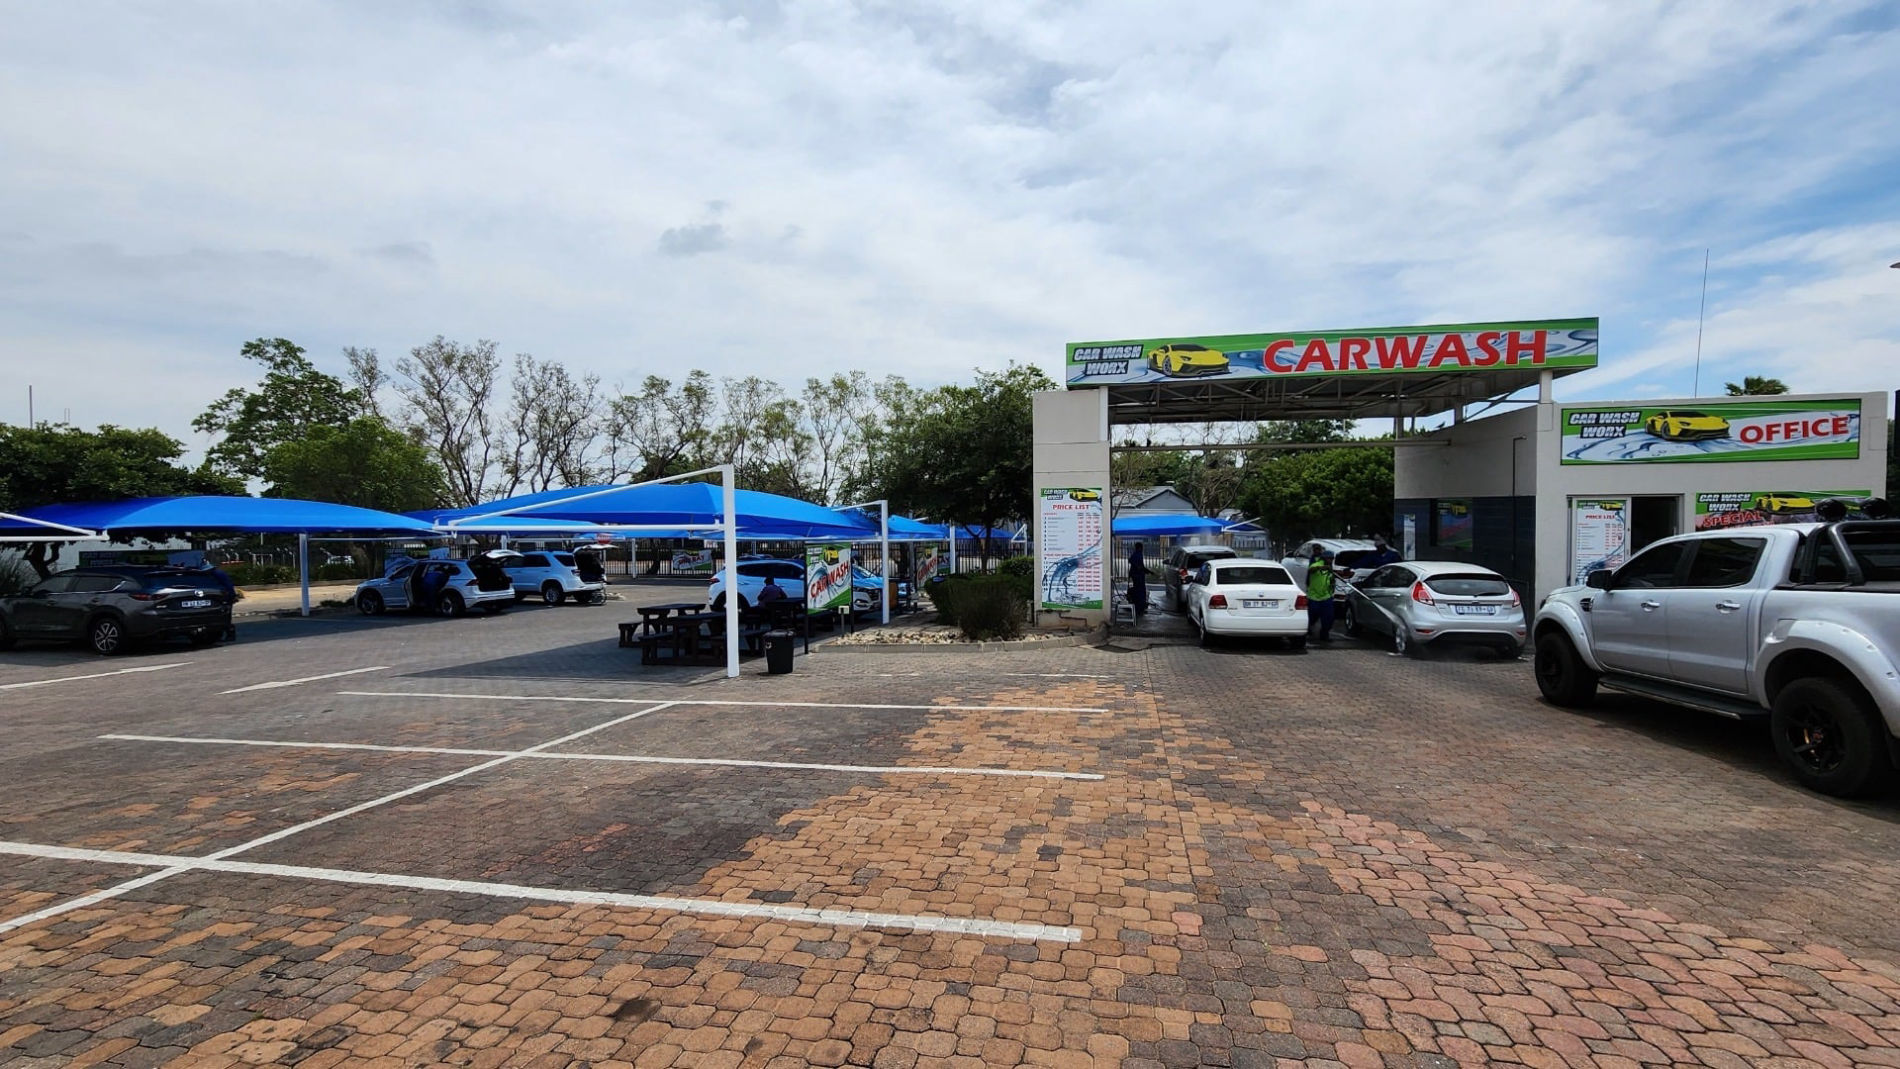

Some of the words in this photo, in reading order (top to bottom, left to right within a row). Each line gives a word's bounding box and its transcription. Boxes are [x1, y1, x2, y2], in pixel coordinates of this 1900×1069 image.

[1074, 347, 1099, 361] CAR
[1102, 345, 1142, 359] WASH
[1262, 330, 1548, 373] CARWASH
[1086, 361, 1127, 375] WORX
[1569, 413, 1598, 424] CAR
[1600, 412, 1639, 423] WASH
[1582, 426, 1625, 438] WORX
[1739, 416, 1850, 444] OFFICE
[1699, 494, 1719, 502] CAR
[1721, 493, 1751, 502] WASH
[1708, 503, 1740, 512] WORX
[1703, 511, 1762, 527] SPECIAL
[810, 560, 849, 598] CARWASH
